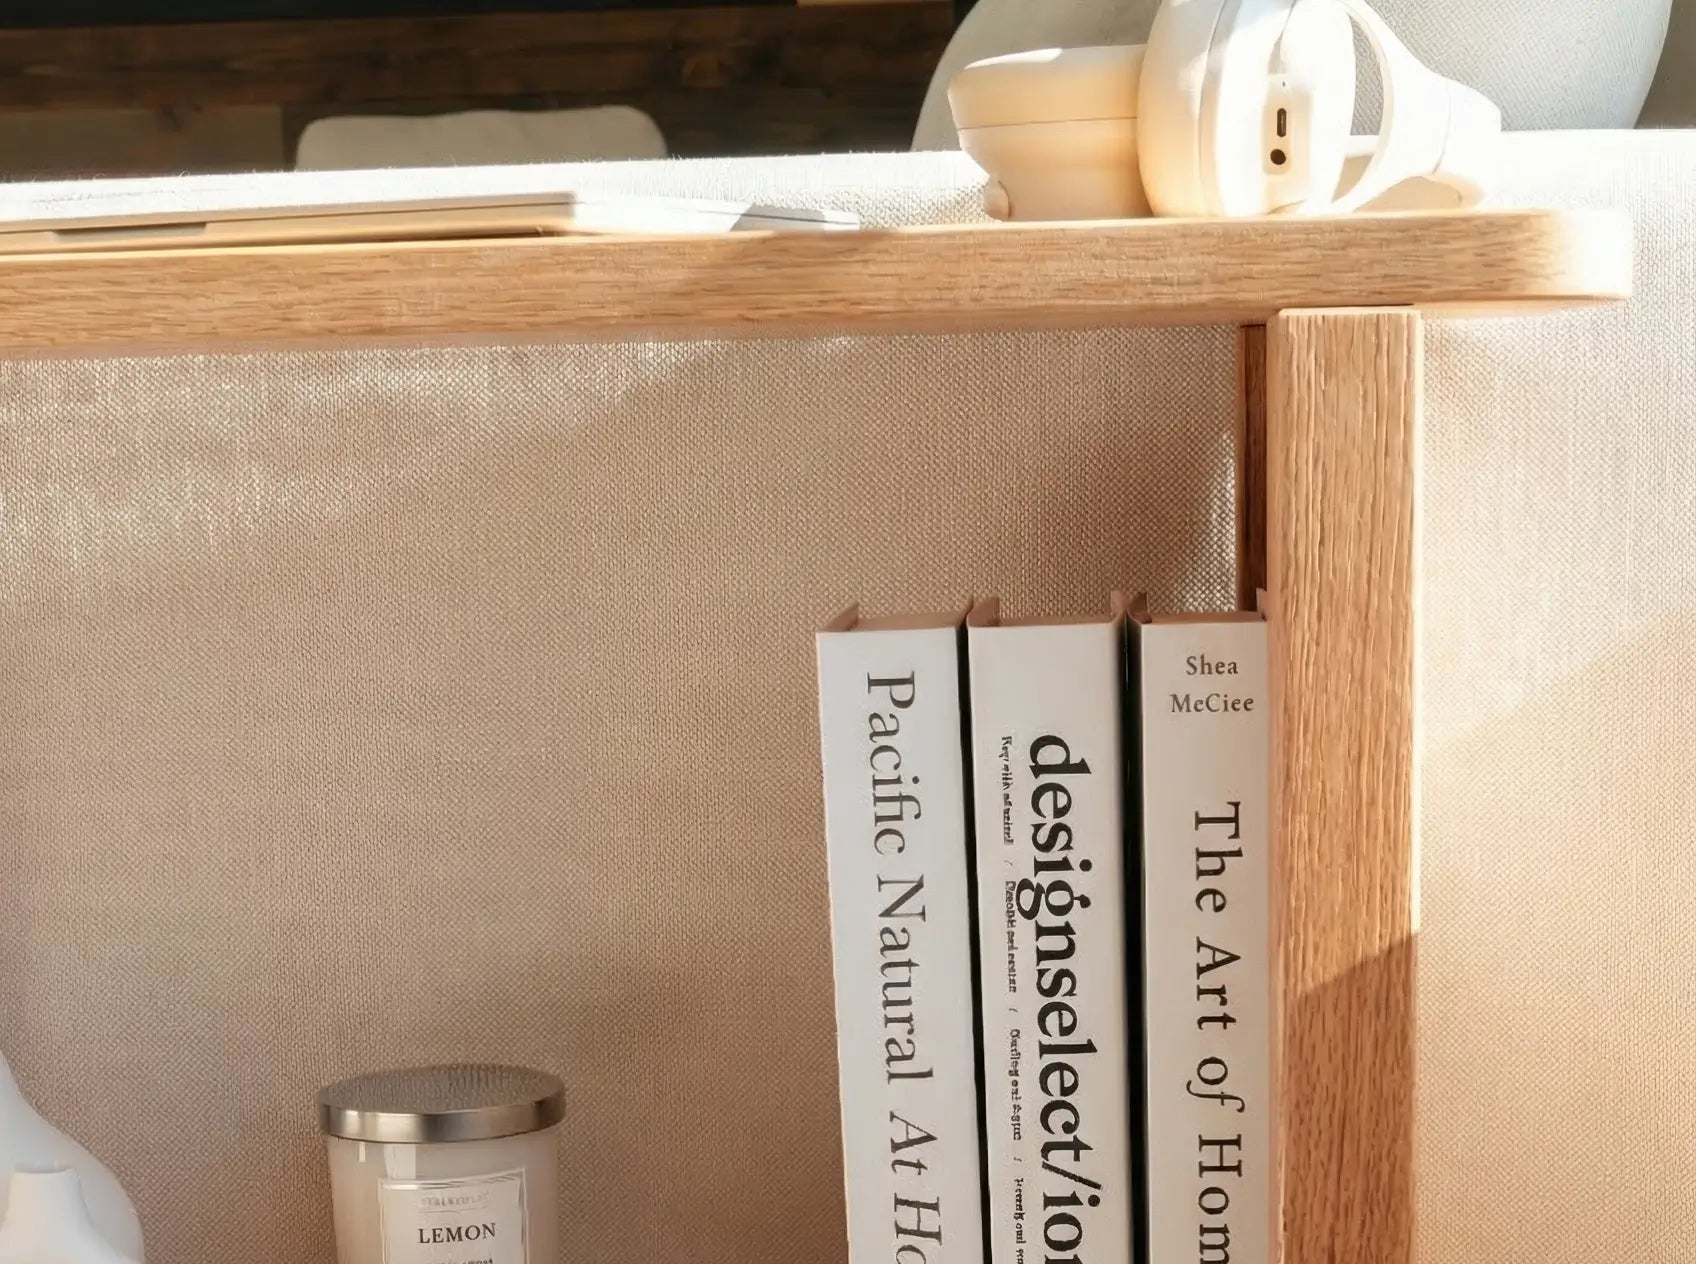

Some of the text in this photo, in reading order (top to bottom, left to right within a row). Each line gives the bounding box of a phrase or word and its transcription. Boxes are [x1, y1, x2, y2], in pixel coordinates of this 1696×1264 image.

[1186, 653, 1239, 675] Shea
[866, 670, 922, 856] Pacific
[1195, 800, 1243, 914] The
[876, 873, 936, 1086] Natural
[1195, 935, 1242, 1031] Art
[1186, 1055, 1246, 1114] of
[888, 1110, 938, 1177] At
[417, 1222, 497, 1244] LEMON
